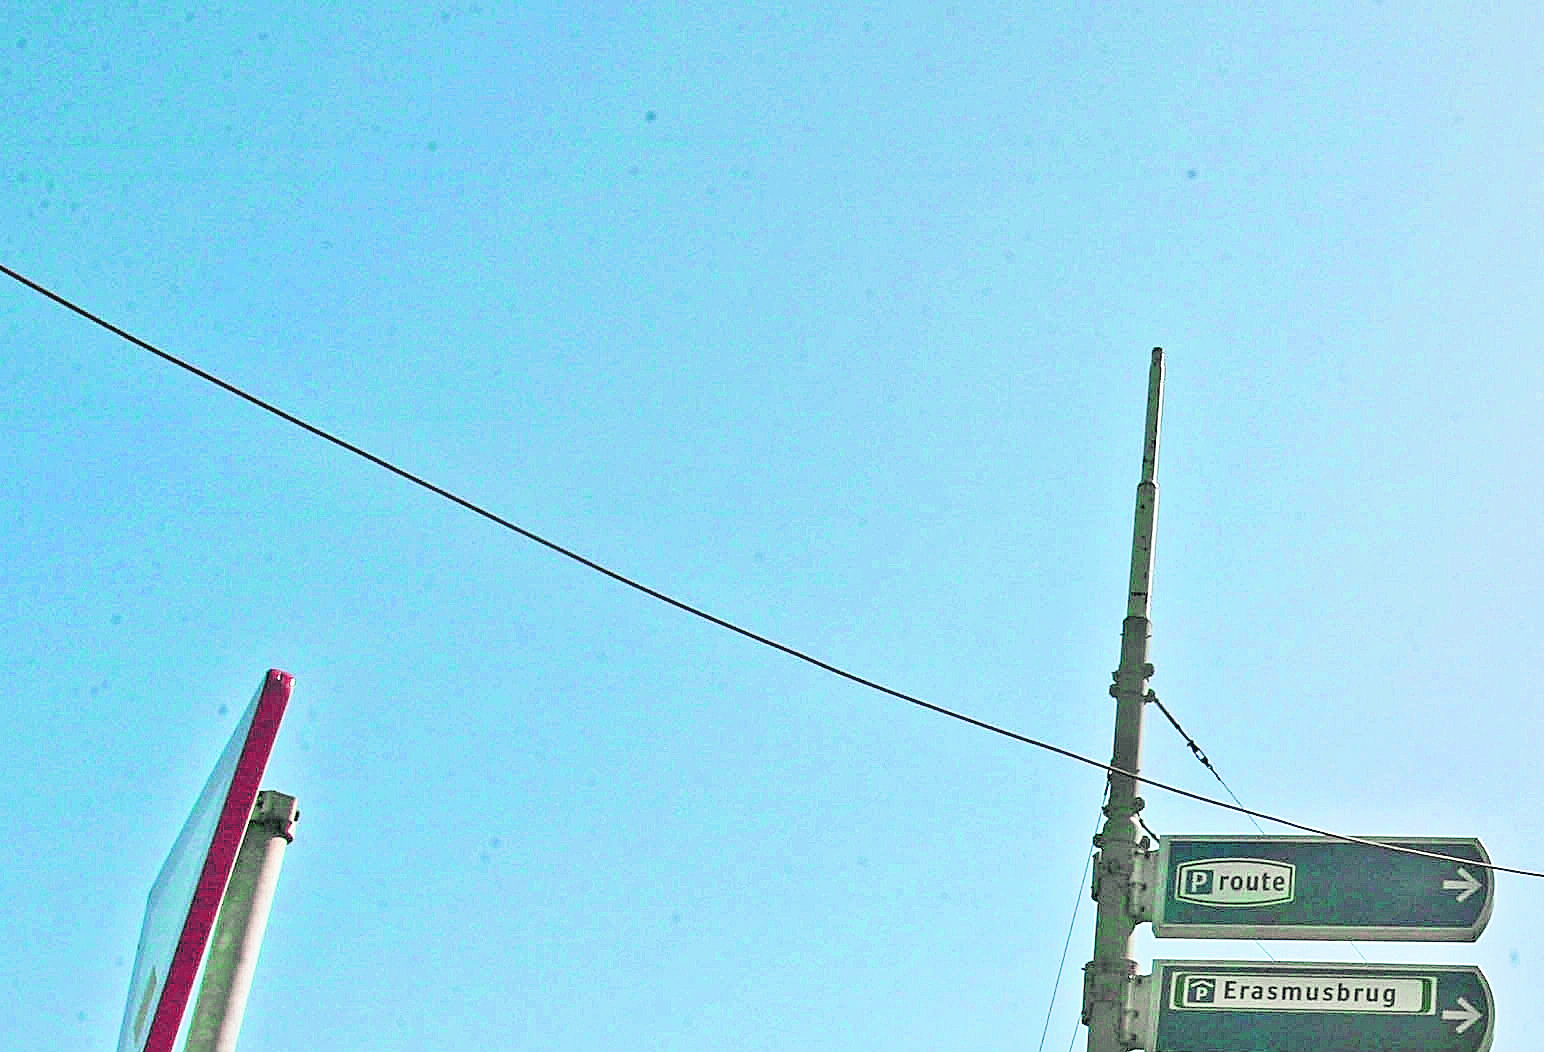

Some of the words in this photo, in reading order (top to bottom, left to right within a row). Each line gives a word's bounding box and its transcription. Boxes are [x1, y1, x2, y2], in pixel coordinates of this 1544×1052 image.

[1192, 871, 1208, 893] P
[1219, 872, 1286, 892] route
[1223, 979, 1397, 1008] Erasmusbrug
